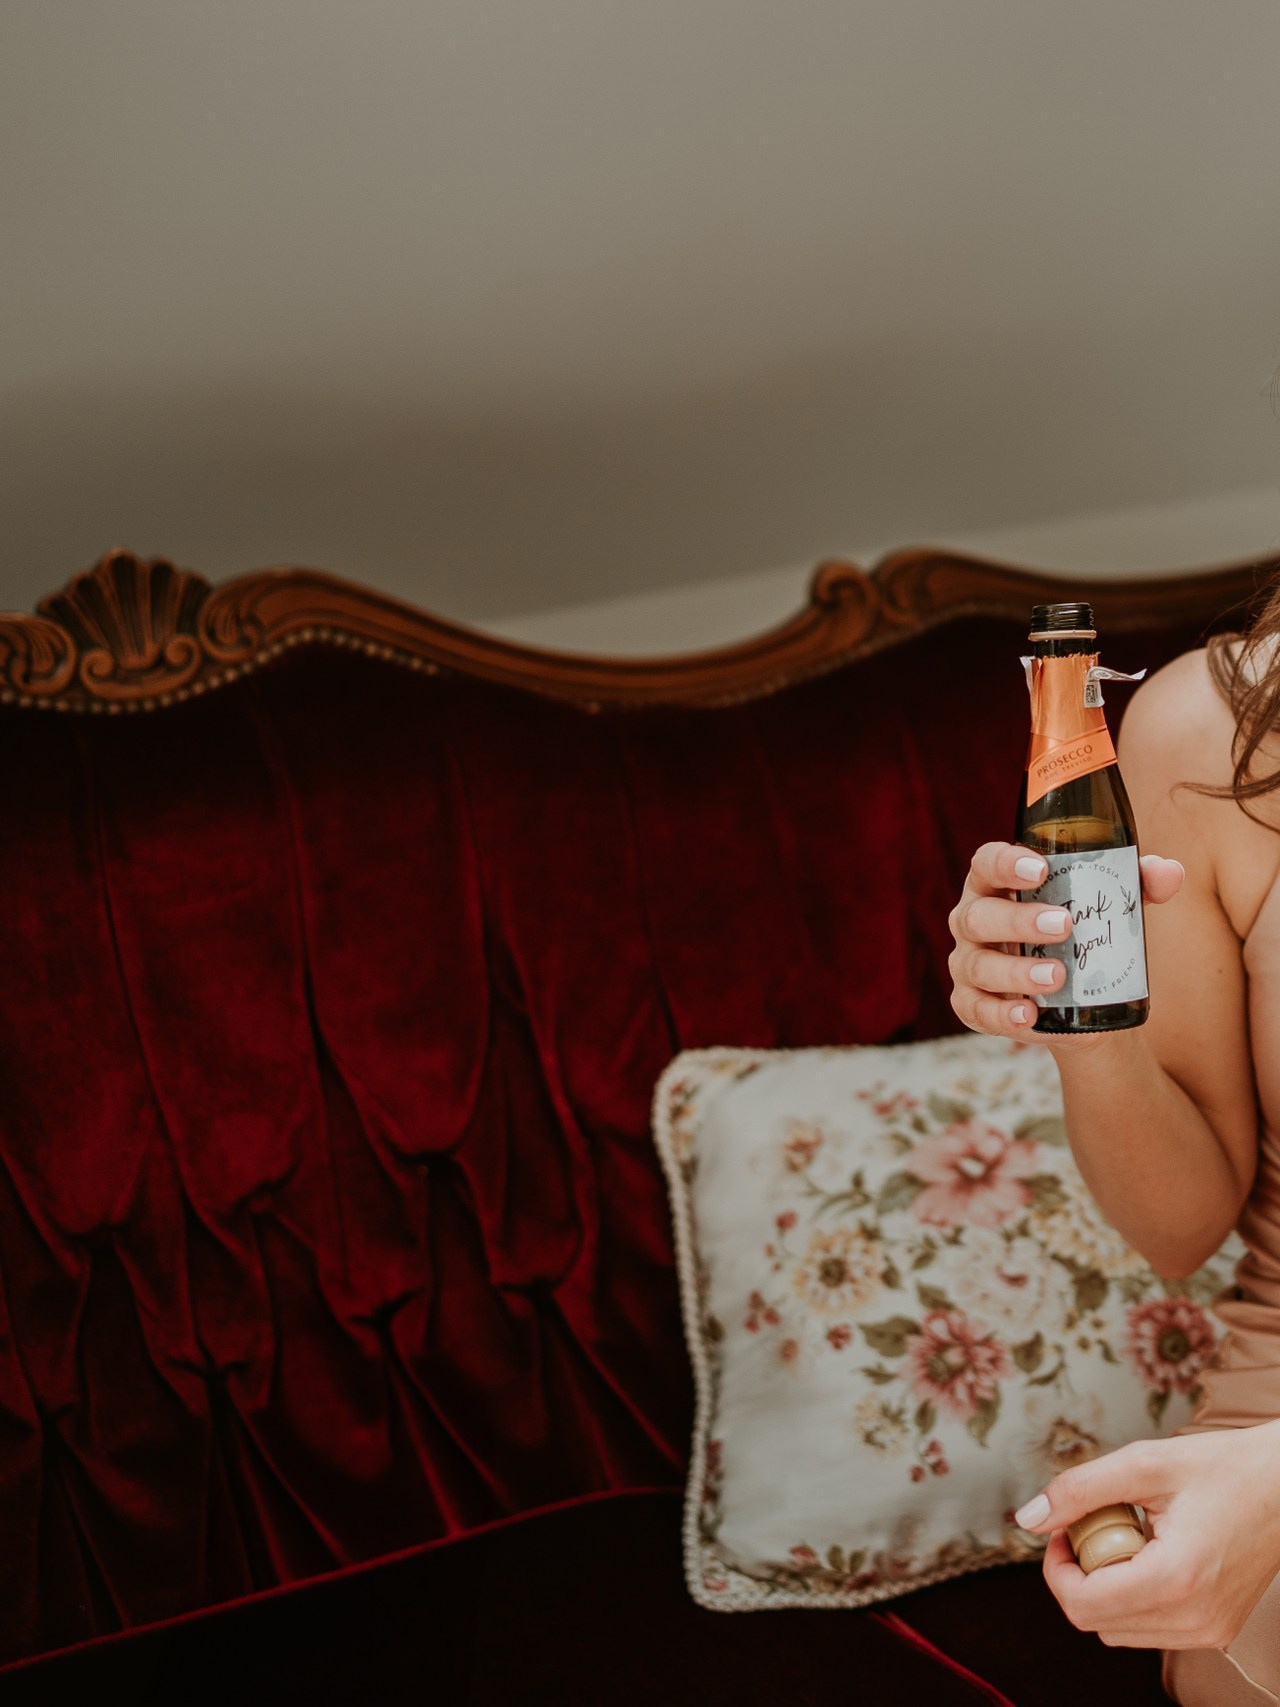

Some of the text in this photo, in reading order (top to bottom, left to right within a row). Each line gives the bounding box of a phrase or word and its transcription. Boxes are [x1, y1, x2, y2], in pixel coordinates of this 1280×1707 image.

[1036, 745, 1093, 778] PROSECCO
[1073, 920, 1112, 970] you!
[1083, 958, 1135, 996] BEST FRIEND
